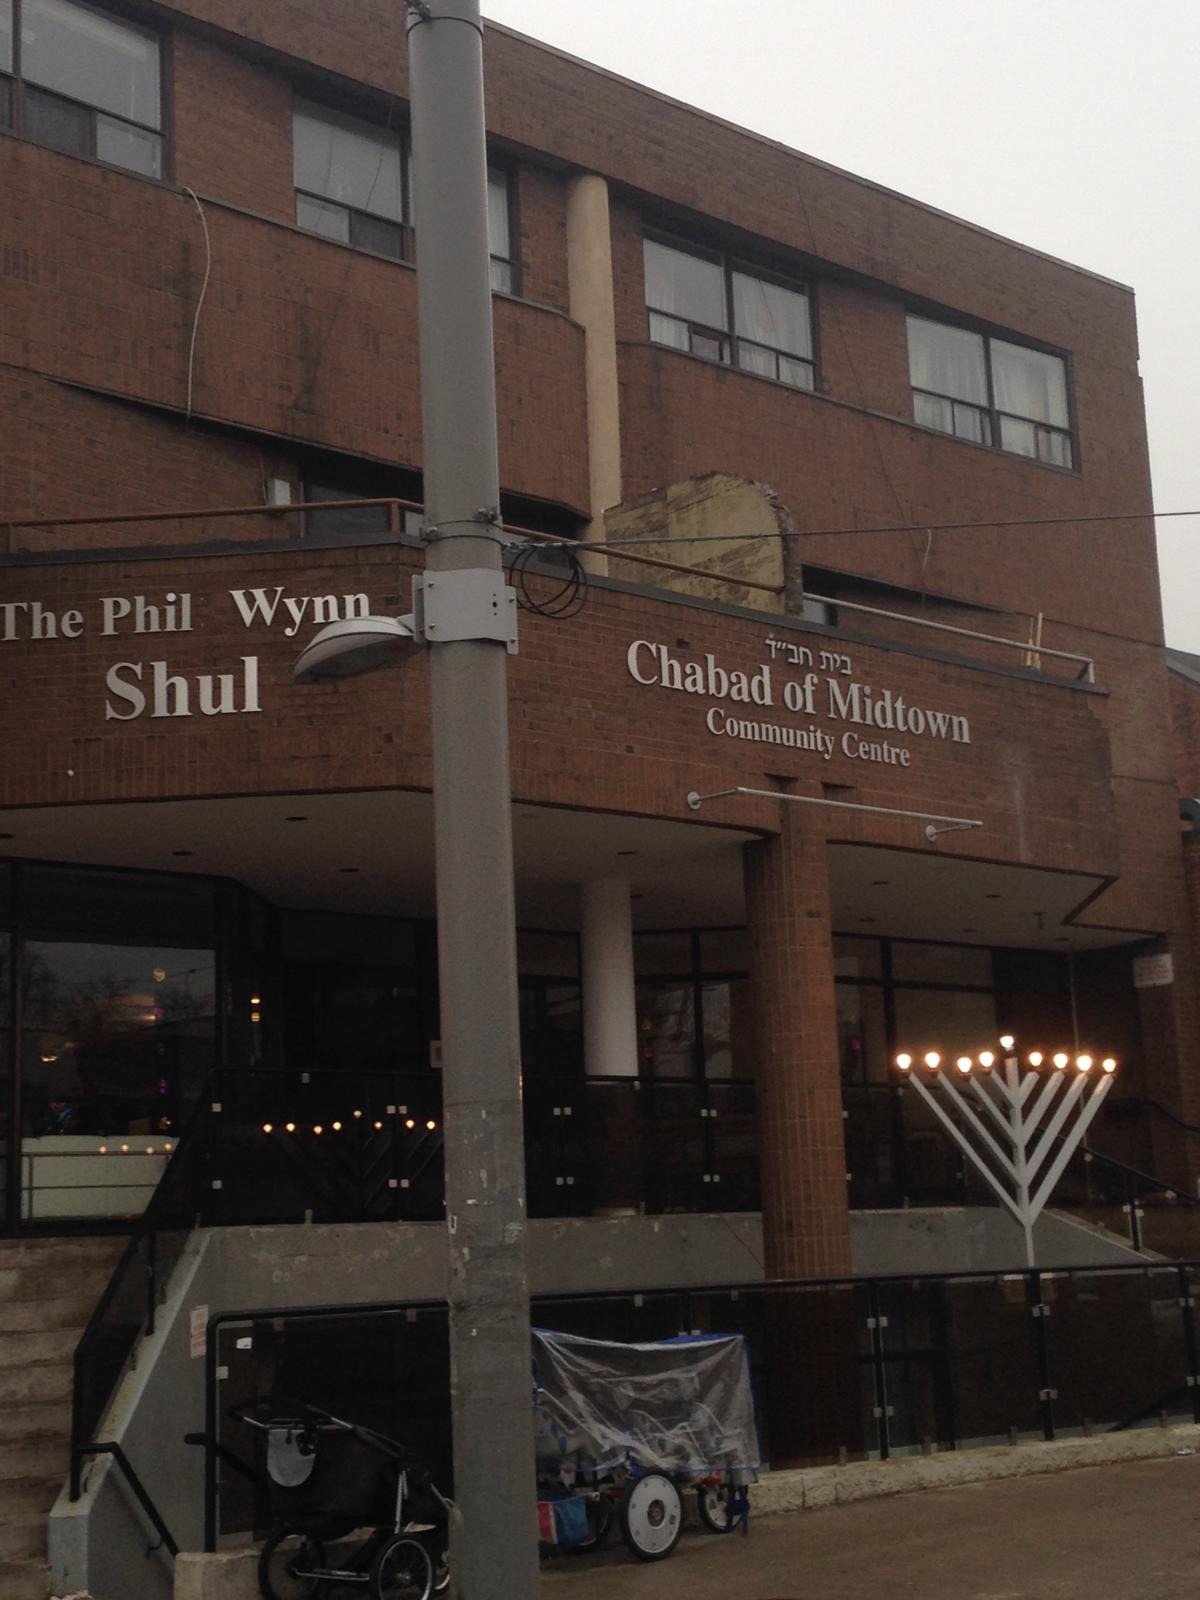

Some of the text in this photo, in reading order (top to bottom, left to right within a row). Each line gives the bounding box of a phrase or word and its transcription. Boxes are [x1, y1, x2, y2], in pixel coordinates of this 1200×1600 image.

[0, 586, 371, 642] The Phil Wynn
[105, 656, 263, 721] Shul
[627, 640, 972, 744] Chabad of Midtown
[819, 649, 853, 676] בית
[706, 707, 911, 767] Community Centre
